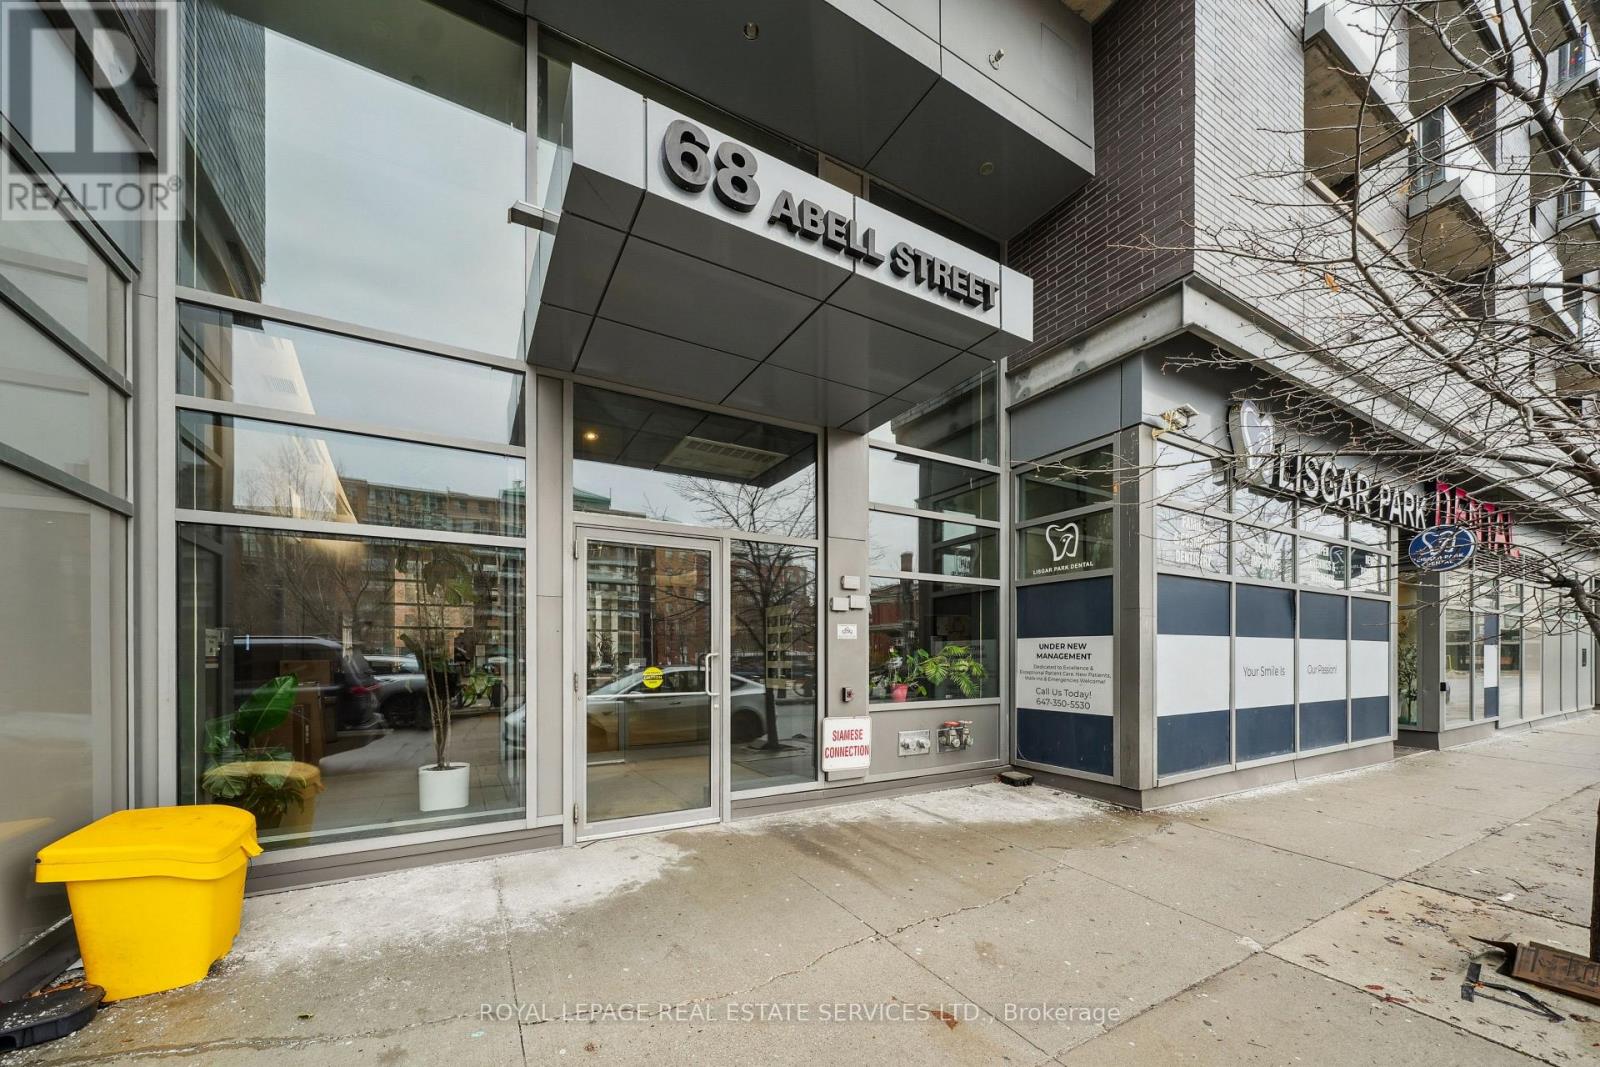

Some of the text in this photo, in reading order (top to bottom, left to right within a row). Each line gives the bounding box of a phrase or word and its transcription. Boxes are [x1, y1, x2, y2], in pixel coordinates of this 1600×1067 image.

[662, 119, 1000, 311] 68 ABELL STREET
[1278, 444, 1371, 515] LISGAR
[1379, 484, 1426, 530] PARK
[1032, 561, 1094, 575] LISGAR PARK DENTAL
[1243, 665, 1259, 677] Your
[1260, 665, 1279, 677] Smile
[1307, 664, 1317, 674] Our
[1035, 687, 1092, 700] Call Us Today!
[1035, 697, 1091, 710] 647-350-5530
[832, 729, 864, 741] SIAMESE
[825, 745, 869, 758] CONNECTION
